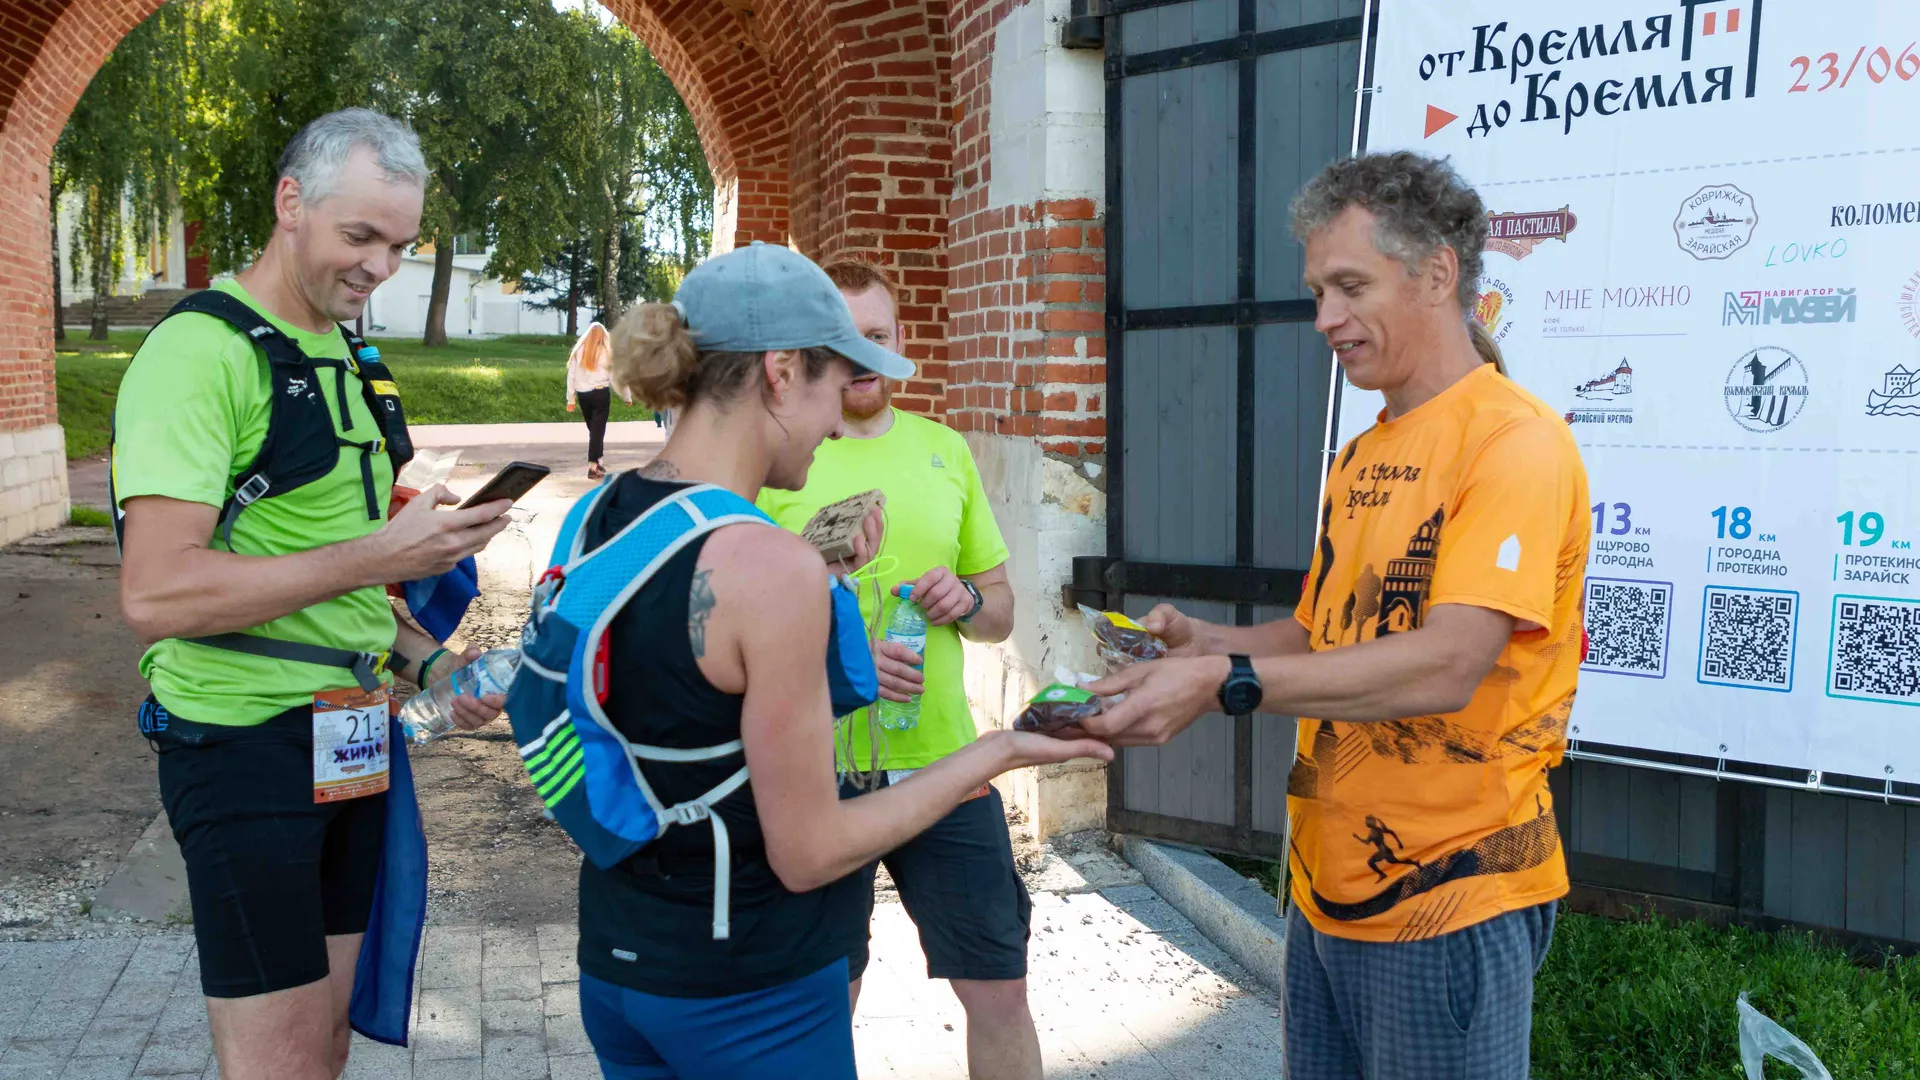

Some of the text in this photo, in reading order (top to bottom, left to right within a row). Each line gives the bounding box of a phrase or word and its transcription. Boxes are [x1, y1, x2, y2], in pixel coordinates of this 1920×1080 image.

[1418, 50, 1466, 81] от
[1466, 99, 1511, 139] до
[1688, 190, 1744, 210] КОВРИЖКА
[1505, 216, 1561, 236] ПАСТИЛА
[1685, 235, 1742, 254] ЗАРАЙСКАЯ
[1765, 238, 1847, 267] LOVKO
[1492, 279, 1514, 305] ДОБРА
[1544, 285, 1691, 310] МНЕ МОЖНО
[1764, 287, 1834, 298] НАВИГАТОР
[1591, 502, 1632, 536] 13
[1711, 505, 1752, 540] 18
[1836, 510, 1884, 547] 19
[1596, 540, 1650, 553] ЩУРОВО
[1717, 547, 1781, 562] ГОРОДНА
[1595, 554, 1654, 569] ГОРОДНА
[1716, 561, 1788, 576] ПРОТЕКИНО
[1844, 569, 1910, 584] ЗАРАЙСК
